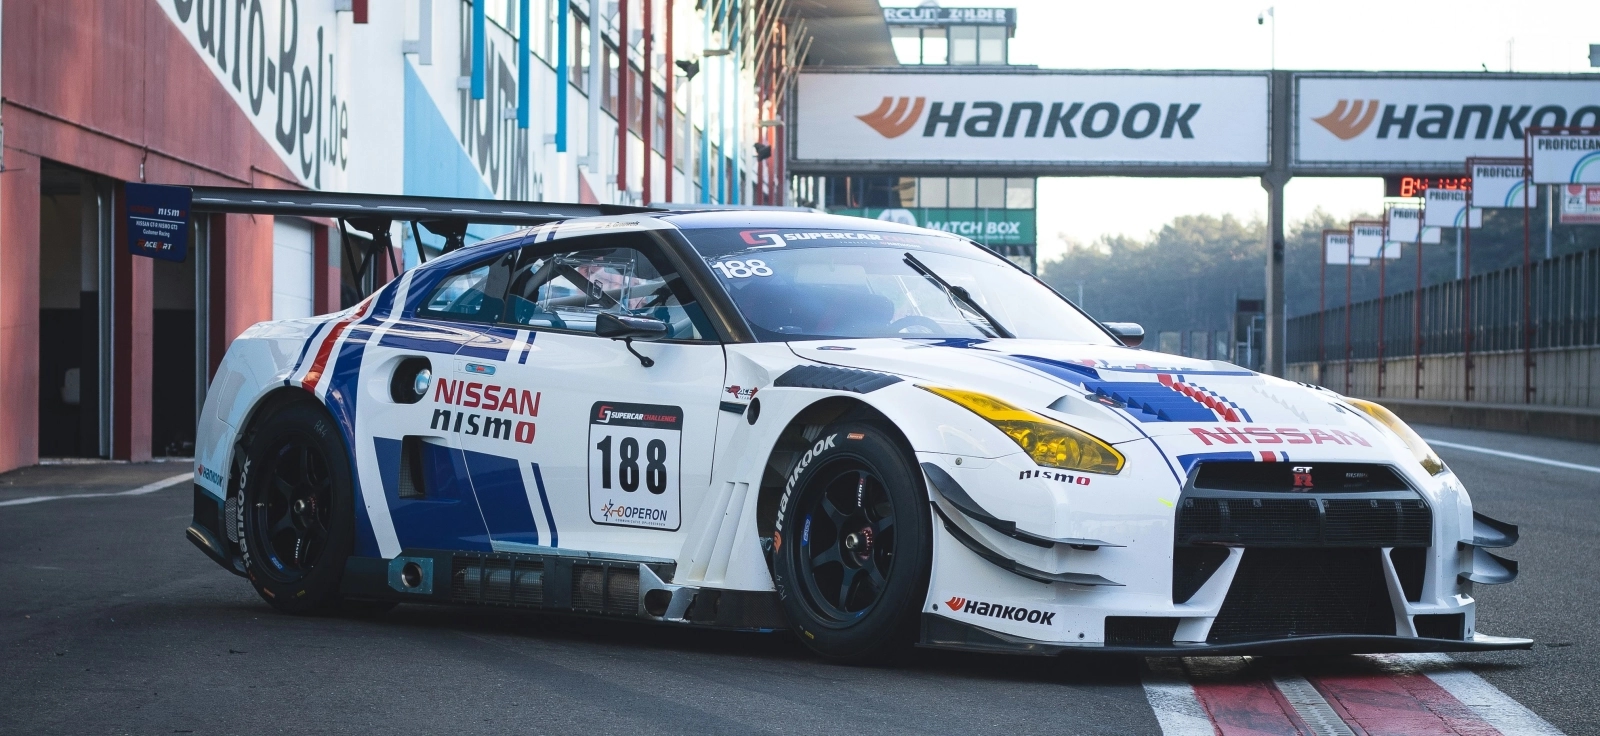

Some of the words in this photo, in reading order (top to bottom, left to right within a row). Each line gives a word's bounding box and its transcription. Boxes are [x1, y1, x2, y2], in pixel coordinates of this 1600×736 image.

[922, 101, 1202, 139] HANKOOK
[786, 232, 884, 241] SUPERCAR
[985, 221, 1021, 234] BOX
[712, 259, 774, 279] 188
[434, 377, 541, 417] NISSAN
[430, 408, 536, 444] nismo
[611, 411, 644, 420] SUPERCAR
[643, 413, 677, 423] CHALLENGE
[1188, 426, 1373, 448] NISSAN
[596, 435, 668, 495] 188
[775, 433, 838, 531] HANKOOK
[1019, 470, 1091, 486] nismo
[964, 600, 1056, 626] HANKOOK
